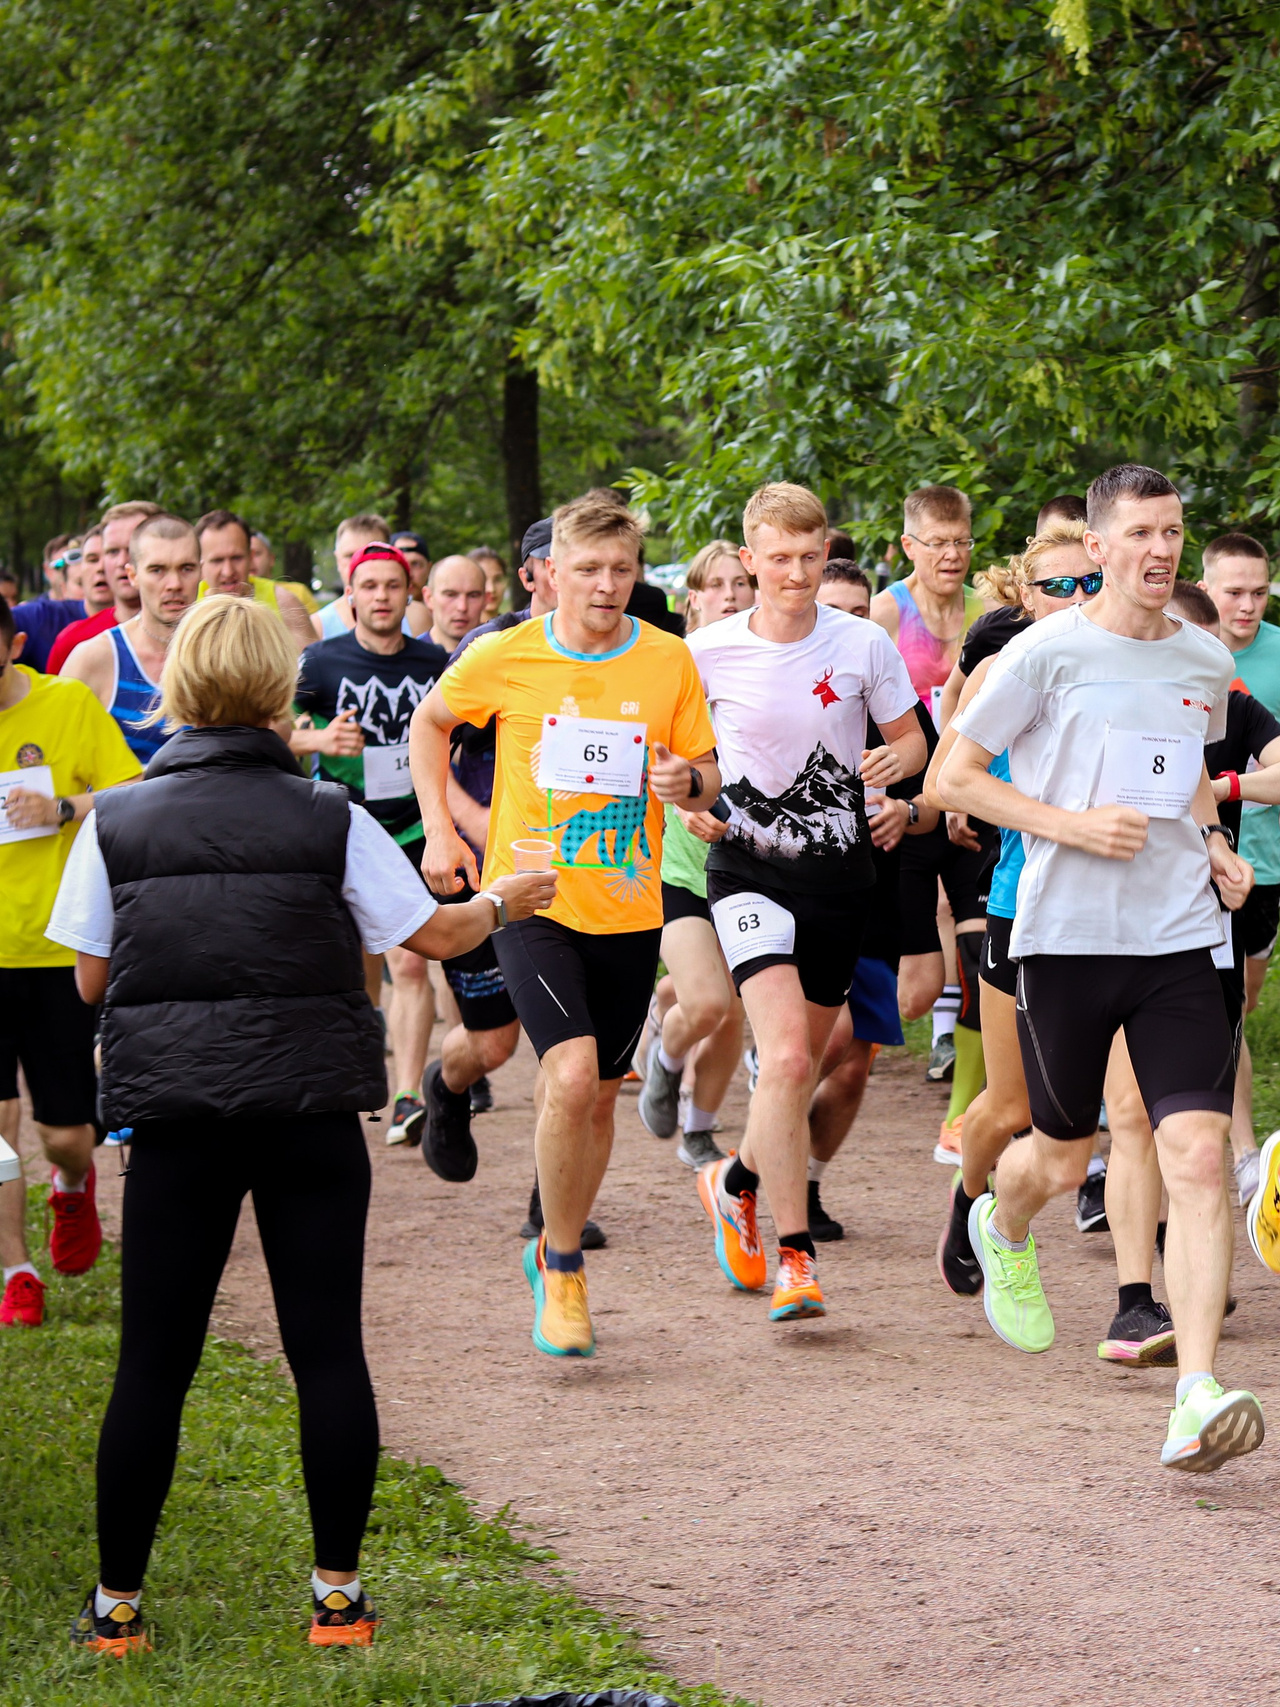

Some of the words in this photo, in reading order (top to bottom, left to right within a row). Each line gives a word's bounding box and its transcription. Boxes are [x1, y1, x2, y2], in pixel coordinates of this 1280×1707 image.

[583, 744, 609, 763] 65
[1153, 755, 1165, 774] 8
[738, 913, 760, 932] 63
